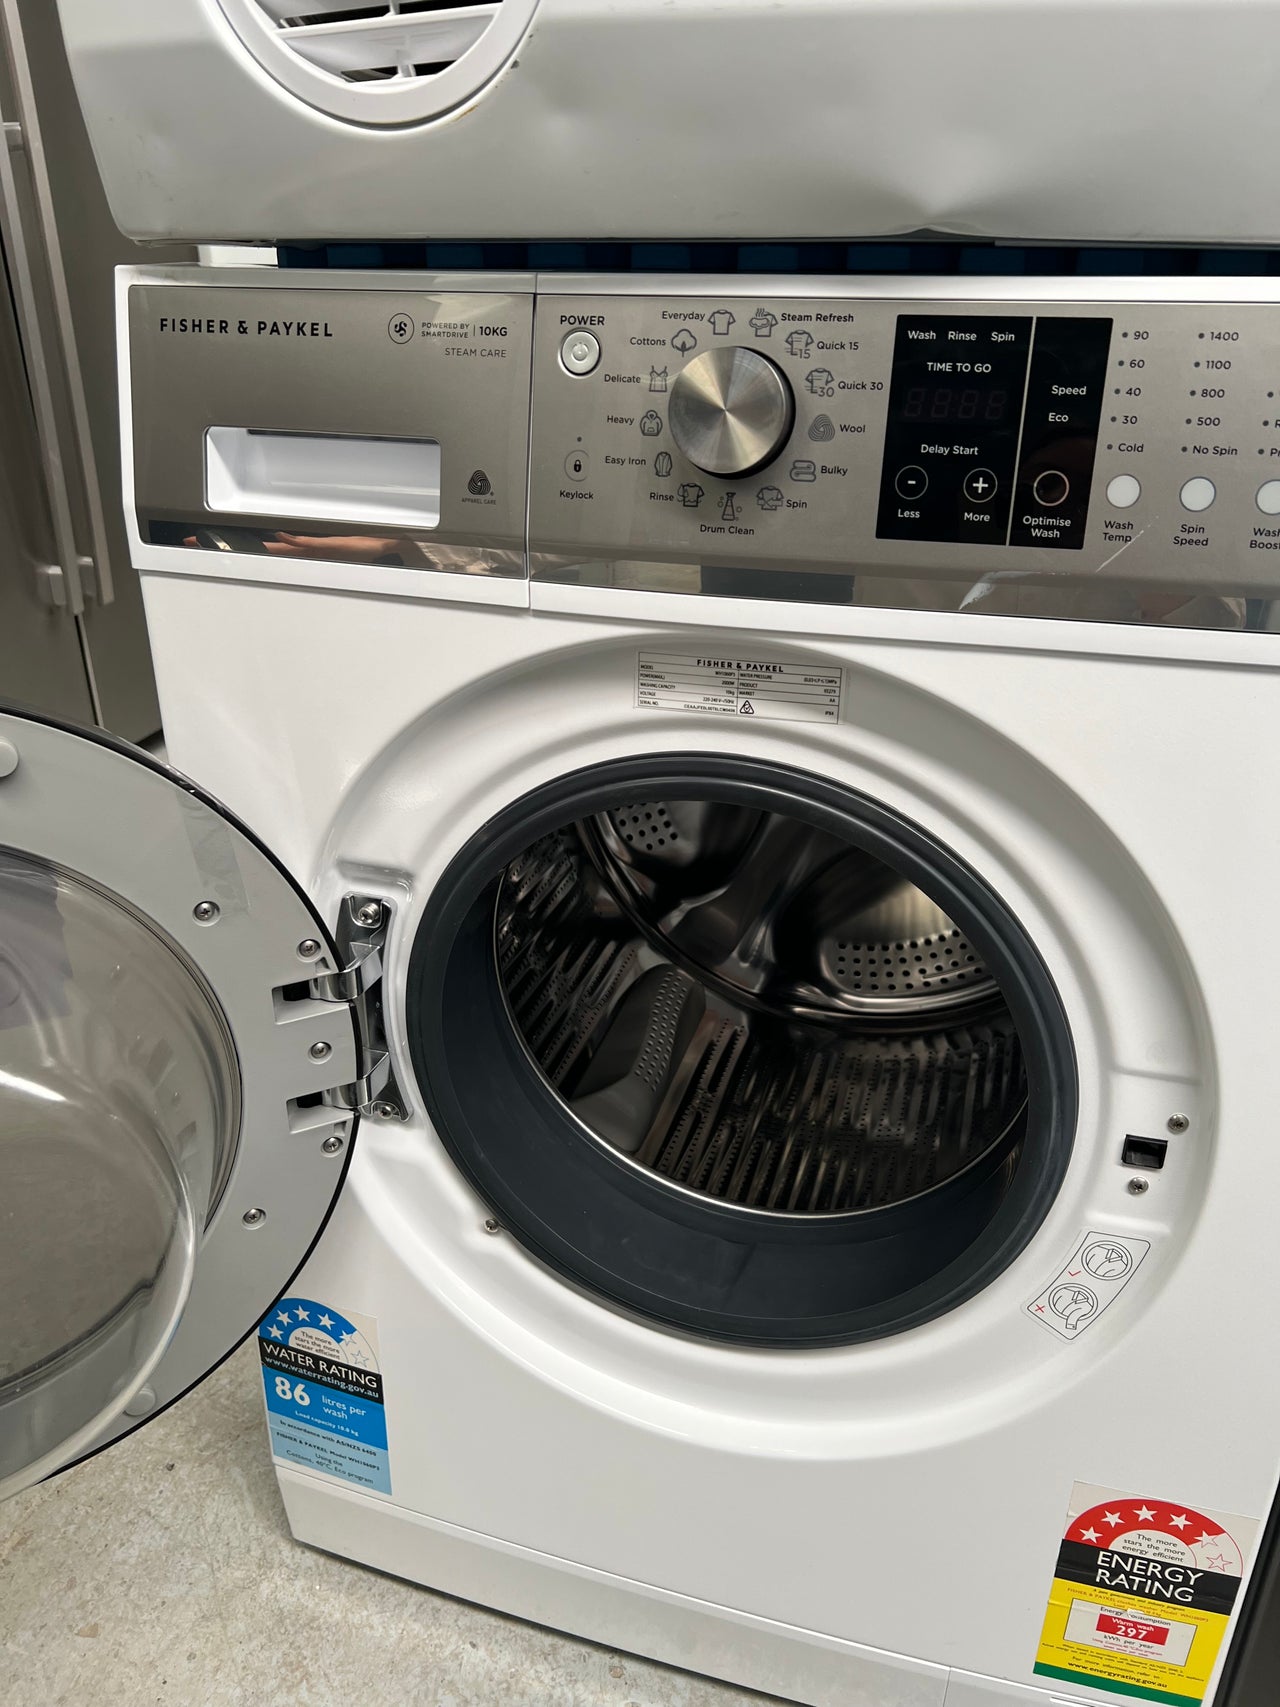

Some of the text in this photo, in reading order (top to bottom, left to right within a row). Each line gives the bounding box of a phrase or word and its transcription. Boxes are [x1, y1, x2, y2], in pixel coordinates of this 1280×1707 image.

[559, 315, 605, 326] POWER
[662, 311, 705, 321] Everyday
[781, 313, 854, 322] Steam Refresh
[160, 318, 332, 337] FISHER & PAYKEL
[421, 322, 457, 330] POWERED
[479, 326, 508, 336] 10KG
[907, 330, 937, 340] Wash
[948, 331, 977, 341] Rinse
[990, 332, 1015, 342] Spin
[1133, 331, 1149, 340] 90
[1210, 332, 1239, 341] 1400
[630, 337, 666, 346] Cottons
[817, 341, 859, 351] Quick 15
[445, 348, 507, 357] STEAM CARE
[927, 362, 992, 373] TIME TO GO
[1129, 360, 1145, 368] 60
[1206, 361, 1231, 370] 1100
[604, 374, 641, 384] Delicate
[838, 381, 883, 391] Quick 30
[1051, 385, 1086, 396] Speed
[818, 387, 835, 397] 30
[1125, 387, 1141, 396] 40
[1201, 389, 1225, 398] 800
[607, 415, 635, 425] Heavy
[1048, 413, 1069, 422] Eco
[1122, 415, 1138, 424] 30
[1197, 417, 1221, 426] 500
[839, 424, 866, 433] Wool
[921, 444, 979, 455] Delay Start
[1118, 443, 1144, 453] Cold
[1193, 446, 1238, 456] No Spin
[605, 456, 646, 466] Easy Iron
[820, 466, 848, 476] Bulky
[560, 490, 594, 500] Keylock
[650, 493, 675, 502] Rinse
[786, 500, 807, 509] Spin
[898, 509, 920, 518] Less
[964, 512, 990, 522] More
[1023, 516, 1071, 526] Optimise
[1104, 520, 1134, 530] Wash
[700, 525, 755, 535] Drum Clean
[1031, 528, 1060, 538] Wash
[1180, 524, 1205, 534] Spin
[1102, 533, 1132, 543] Temp
[1173, 536, 1209, 546] Speed
[1250, 540, 1280, 550] Boos
[697, 659, 733, 669] FISHER
[746, 663, 784, 673] PAYKEL
[301, 1331, 332, 1345] The more
[311, 1340, 321, 1348] the
[323, 1344, 340, 1353] more
[263, 1342, 377, 1388] WATER RATING
[265, 1356, 379, 1398] www.waterrating.gov.au
[275, 1376, 310, 1406] 86
[322, 1395, 366, 1417] litres per
[323, 1406, 348, 1420] wash
[1136, 1533, 1178, 1548] The more
[1124, 1538, 1186, 1556] stars the more
[1122, 1545, 1184, 1563] energy efficient
[1097, 1551, 1204, 1586] ENERGY
[1096, 1568, 1194, 1602] RATING
[1100, 1606, 1124, 1617] Energy
[1128, 1613, 1171, 1627] onsumption
[1112, 1617, 1154, 1632] Warm wash
[1116, 1625, 1148, 1640] 297
[1103, 1634, 1120, 1642] kWh
[1068, 1662, 1167, 1688] www.energyrating.gov.au
